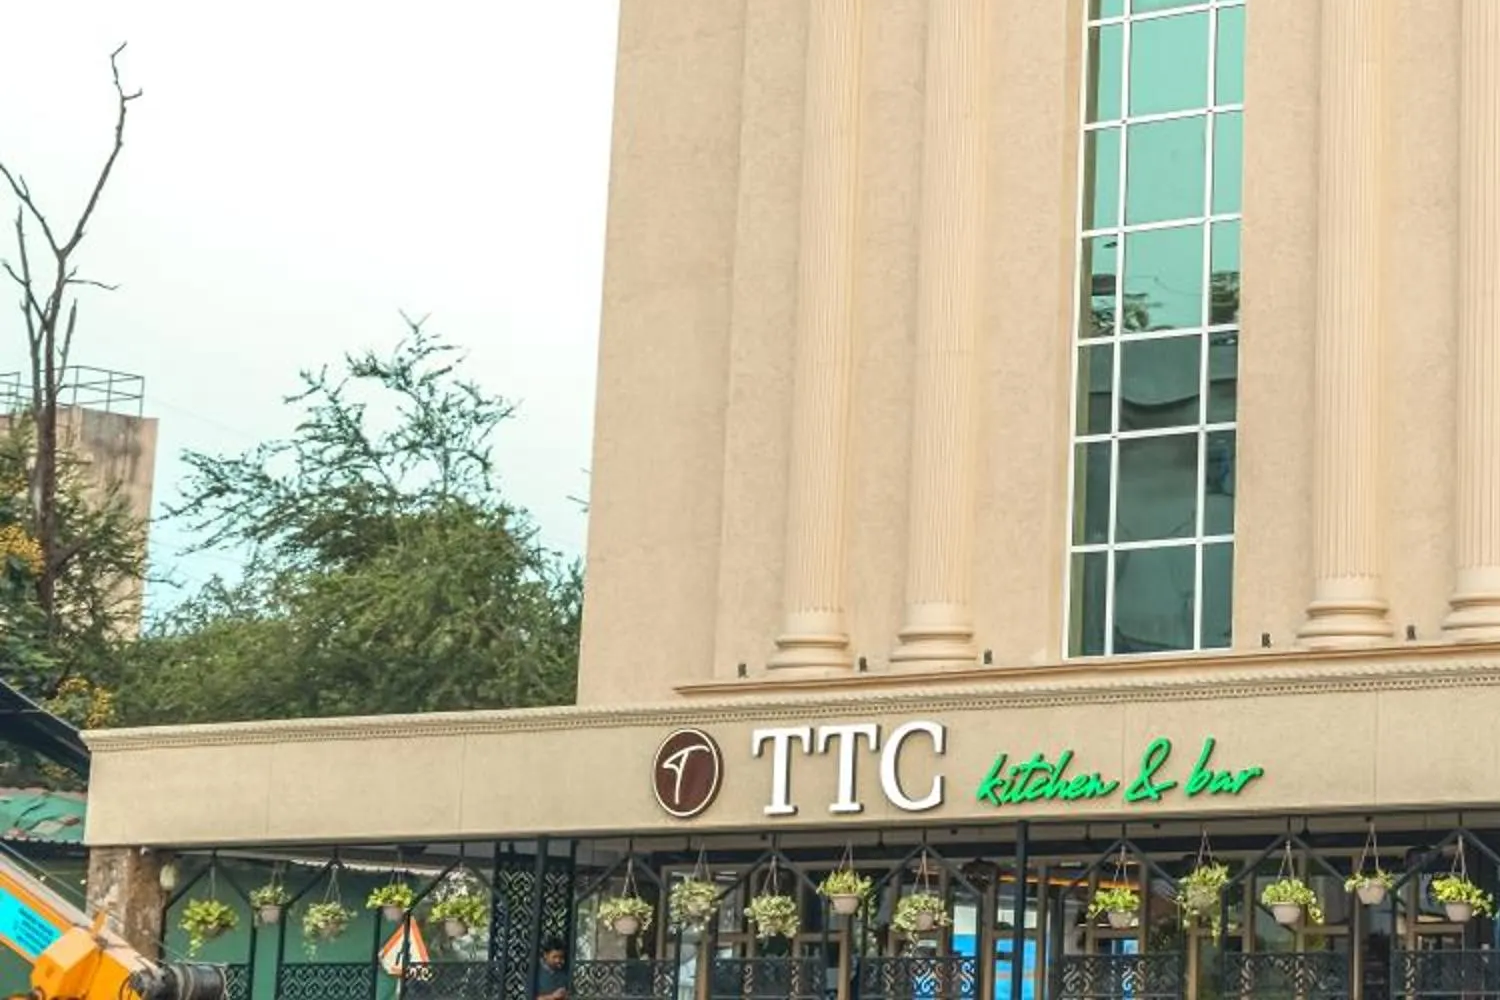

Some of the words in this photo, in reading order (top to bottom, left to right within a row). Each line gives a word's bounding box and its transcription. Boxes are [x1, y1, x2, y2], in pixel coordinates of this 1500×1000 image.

[752, 720, 946, 816] TTC
[977, 750, 1120, 806] kitchen
[1124, 737, 1178, 802] &
[1184, 737, 1264, 796] bar
